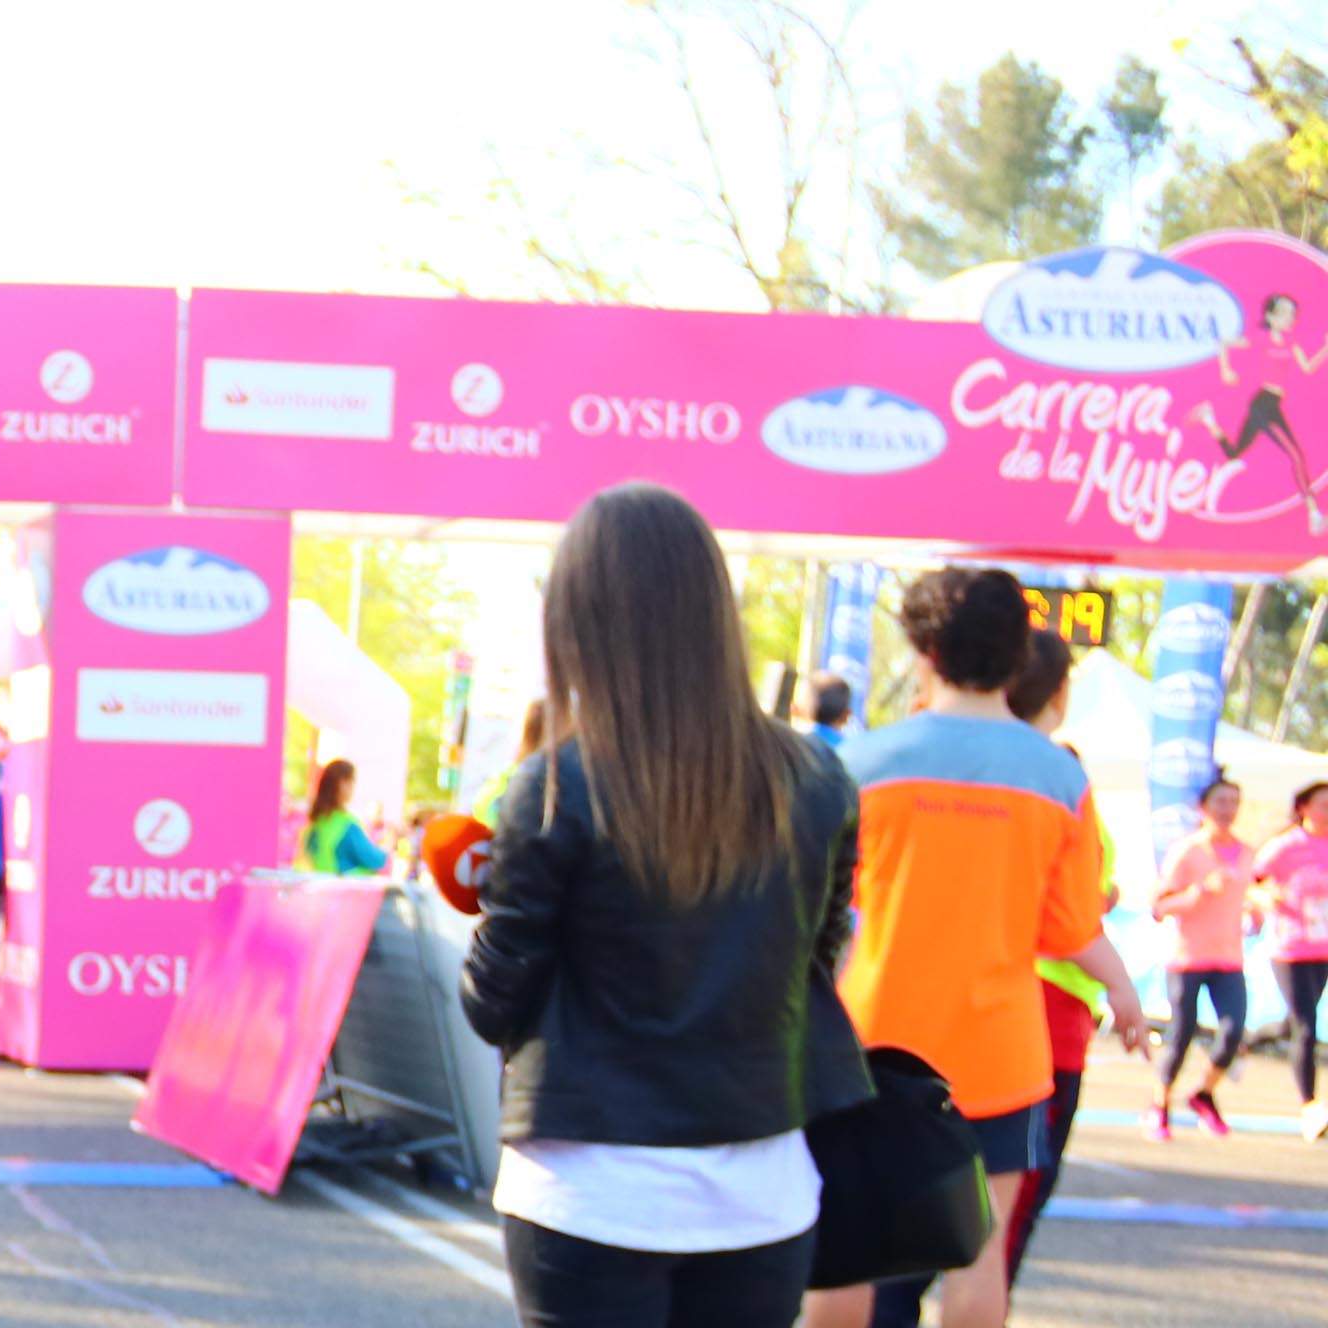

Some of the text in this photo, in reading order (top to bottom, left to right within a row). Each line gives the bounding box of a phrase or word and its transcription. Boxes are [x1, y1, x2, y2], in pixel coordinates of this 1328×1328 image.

[1002, 291, 1221, 342] ASTURIANA
[950, 357, 1173, 435] Carrera
[0, 410, 132, 445] ZURICH
[410, 421, 541, 457] ZURICH
[570, 394, 741, 444] OYSHO
[778, 417, 934, 453] ASTURIANA
[998, 430, 1247, 542] de la Mujer
[100, 579, 255, 614] ASTURIANA
[67, 953, 188, 997] OYS
